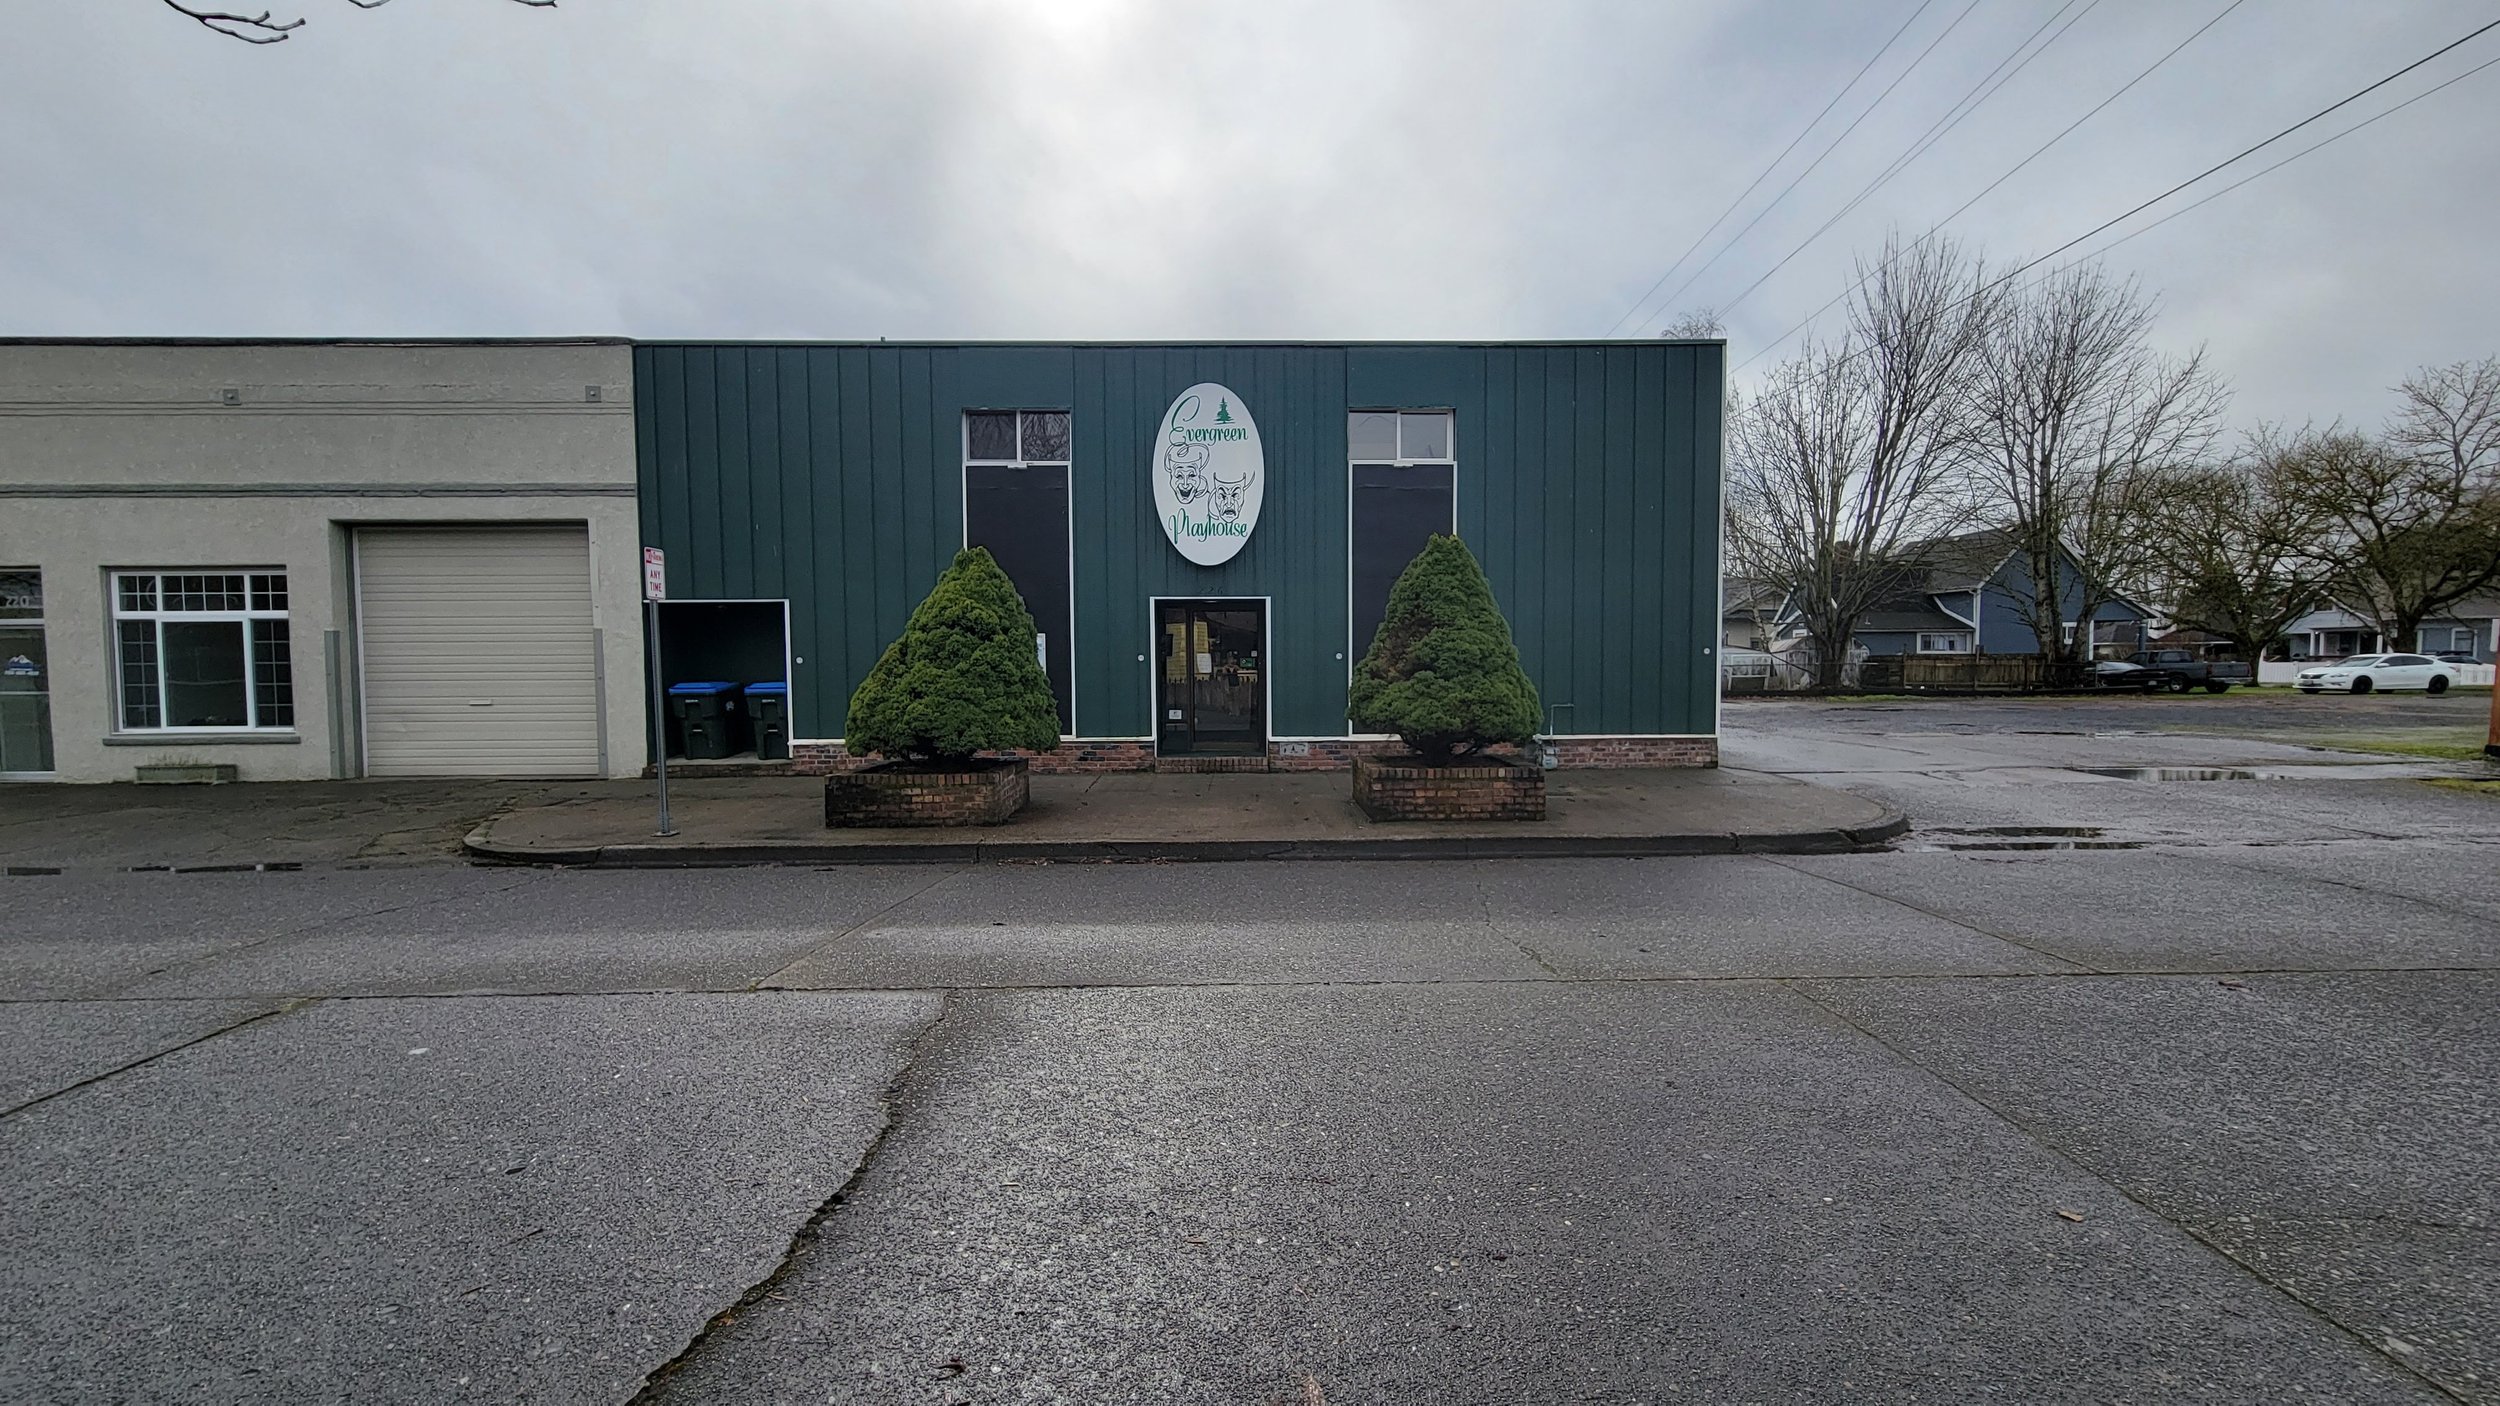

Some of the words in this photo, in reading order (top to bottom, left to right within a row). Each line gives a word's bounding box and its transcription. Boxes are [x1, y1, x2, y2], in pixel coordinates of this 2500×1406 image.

[1169, 395, 1248, 447] Evergreen
[1168, 508, 1248, 544] Playhouse
[650, 569, 661, 580] ANY
[650, 581, 662, 592] TIME
